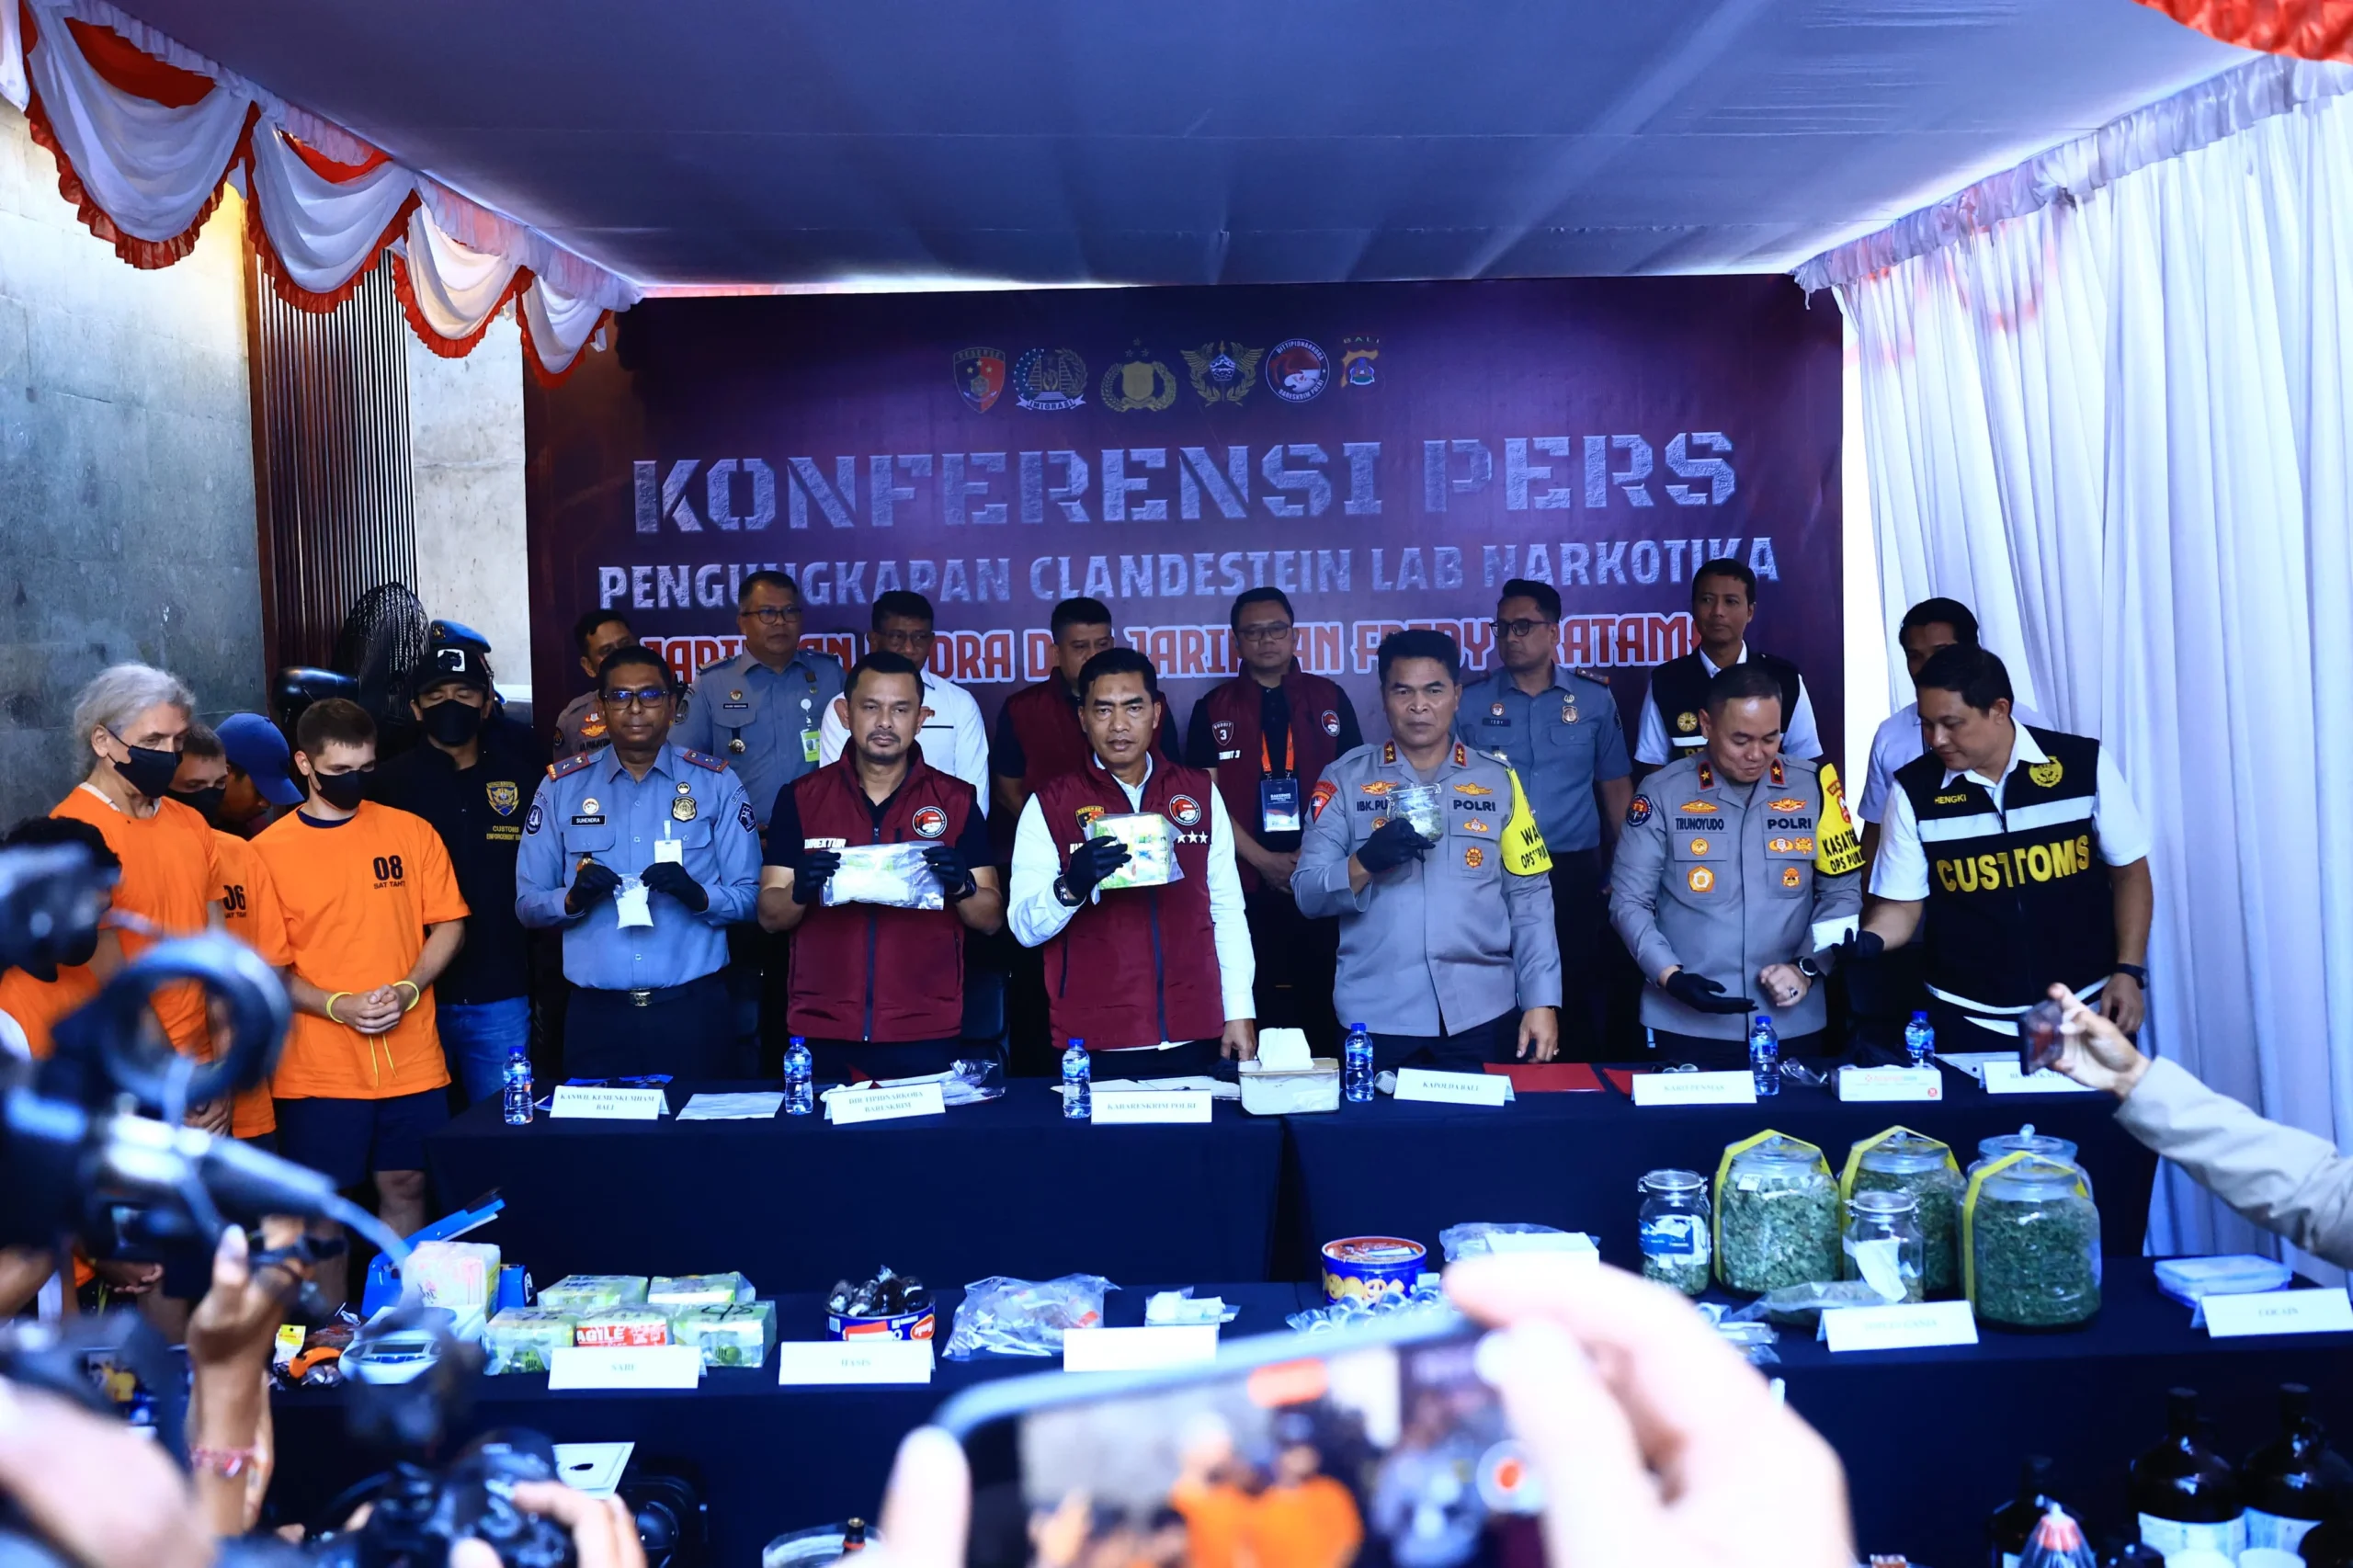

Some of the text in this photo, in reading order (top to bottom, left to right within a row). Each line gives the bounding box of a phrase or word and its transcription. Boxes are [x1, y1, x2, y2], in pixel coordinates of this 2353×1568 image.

[1029, 398, 1074, 410] IMIGRASI
[632, 430, 1736, 534] KONFERENSI PERS
[1030, 548, 1351, 601] CLANDESTEIN
[1371, 545, 1462, 593] LAB
[1220, 729, 1227, 740] 3
[1453, 799, 1496, 812] POLRI
[1934, 794, 1967, 804] HENGKI
[1675, 817, 1724, 831] TRUNOYUDO
[1767, 817, 1813, 830] POLRI
[803, 837, 847, 849] DIREKTUR
[372, 855, 404, 881] 08
[1829, 857, 1847, 872] OPS
[1936, 835, 2090, 892] CUSTOMS
